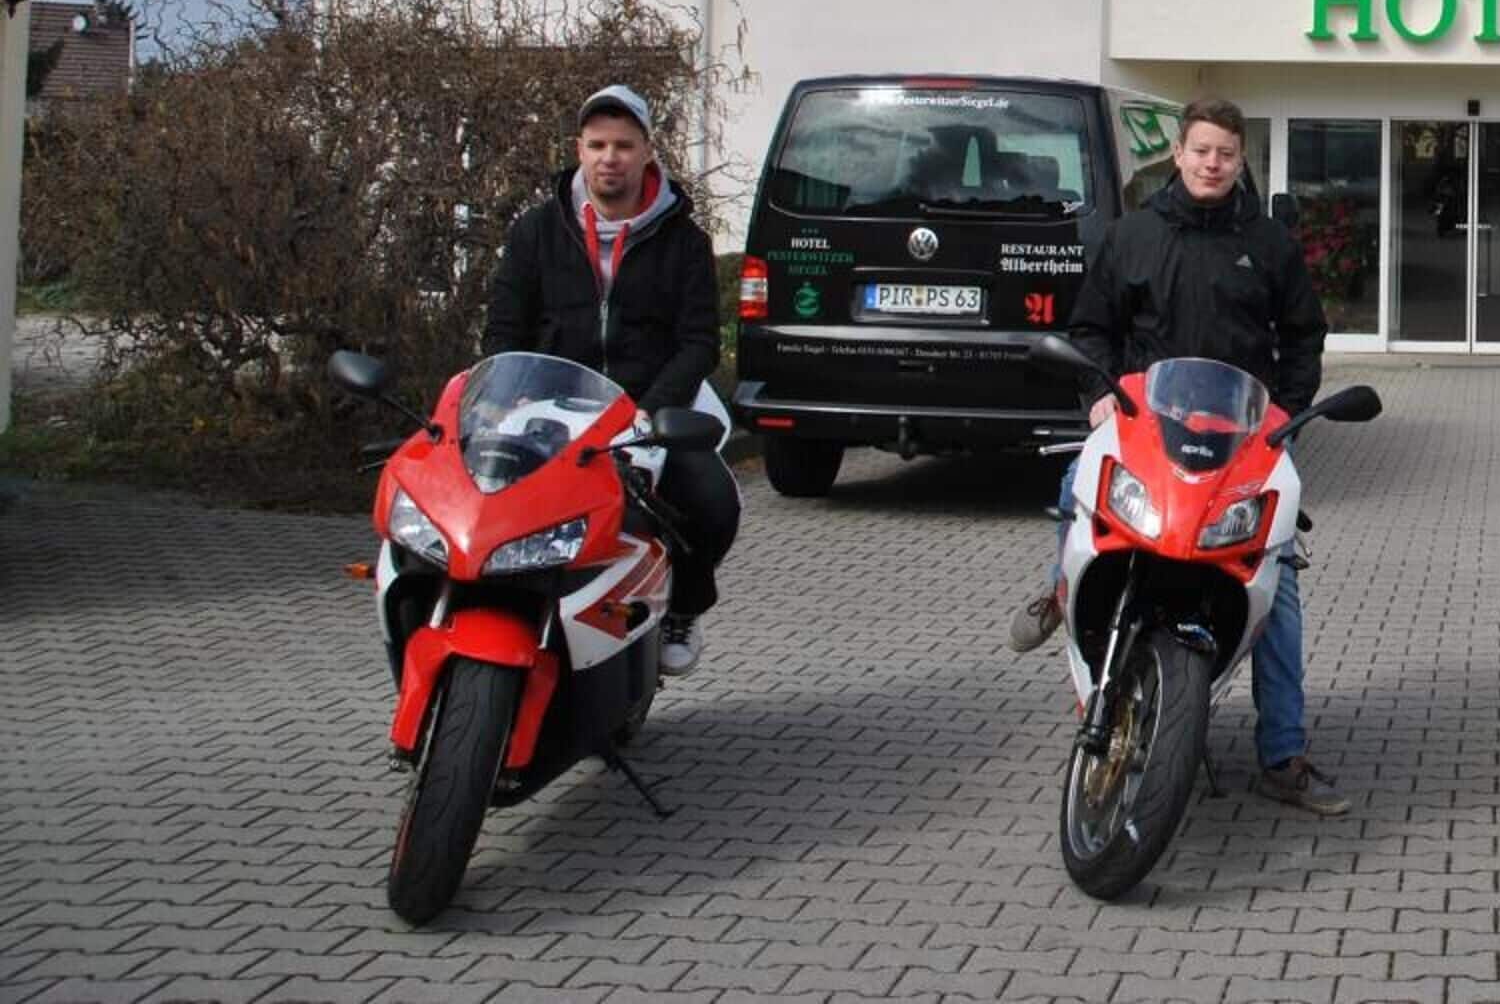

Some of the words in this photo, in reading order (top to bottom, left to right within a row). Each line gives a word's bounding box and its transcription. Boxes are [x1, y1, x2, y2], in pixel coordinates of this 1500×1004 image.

[791, 237, 832, 250] HOTEL
[1001, 243, 1085, 257] RESTAURANT
[1000, 257, 1083, 276] Albertheim
[879, 287, 913, 307] PIR
[927, 288, 950, 307] PS
[955, 289, 979, 309] 63
